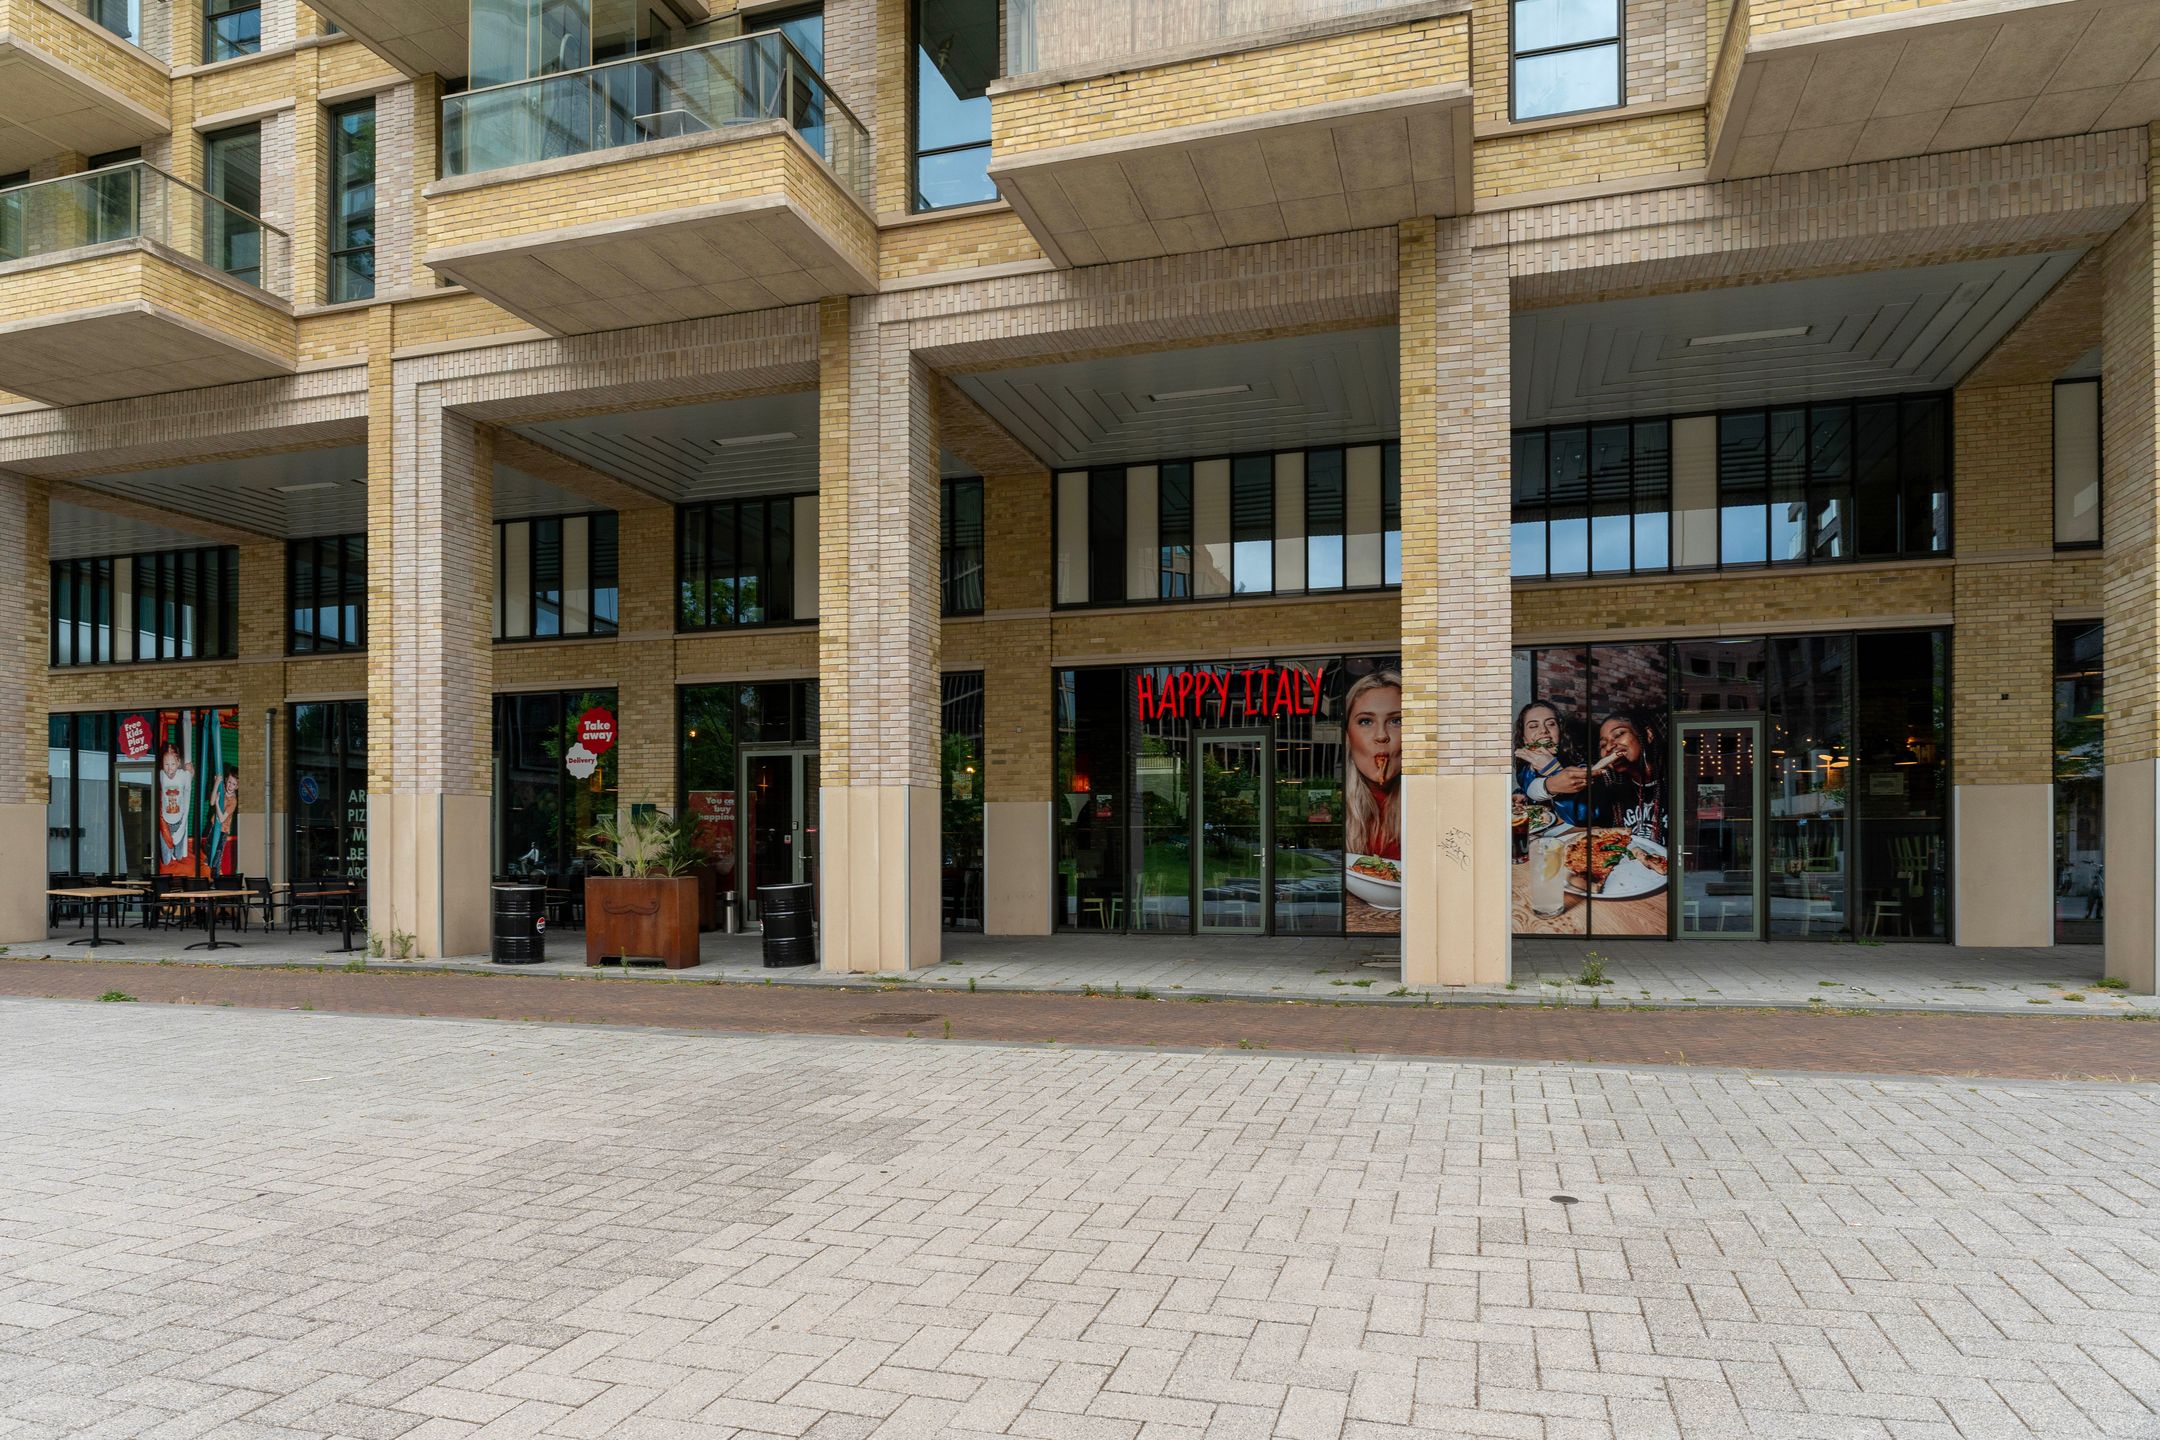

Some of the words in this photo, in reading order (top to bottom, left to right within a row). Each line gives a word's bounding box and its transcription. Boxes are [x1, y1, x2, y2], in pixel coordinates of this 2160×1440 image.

[1136, 671, 1231, 721] HAPPY
[1240, 667, 1324, 717] ITALY
[125, 721, 141, 731] Free
[584, 720, 611, 730] Take
[126, 728, 143, 740] Kids
[582, 732, 613, 742] away
[128, 736, 145, 747] Play
[129, 744, 148, 755] Zone
[705, 797, 722, 805] You
[714, 804, 731, 814] buy
[348, 809, 367, 822] PIZ
